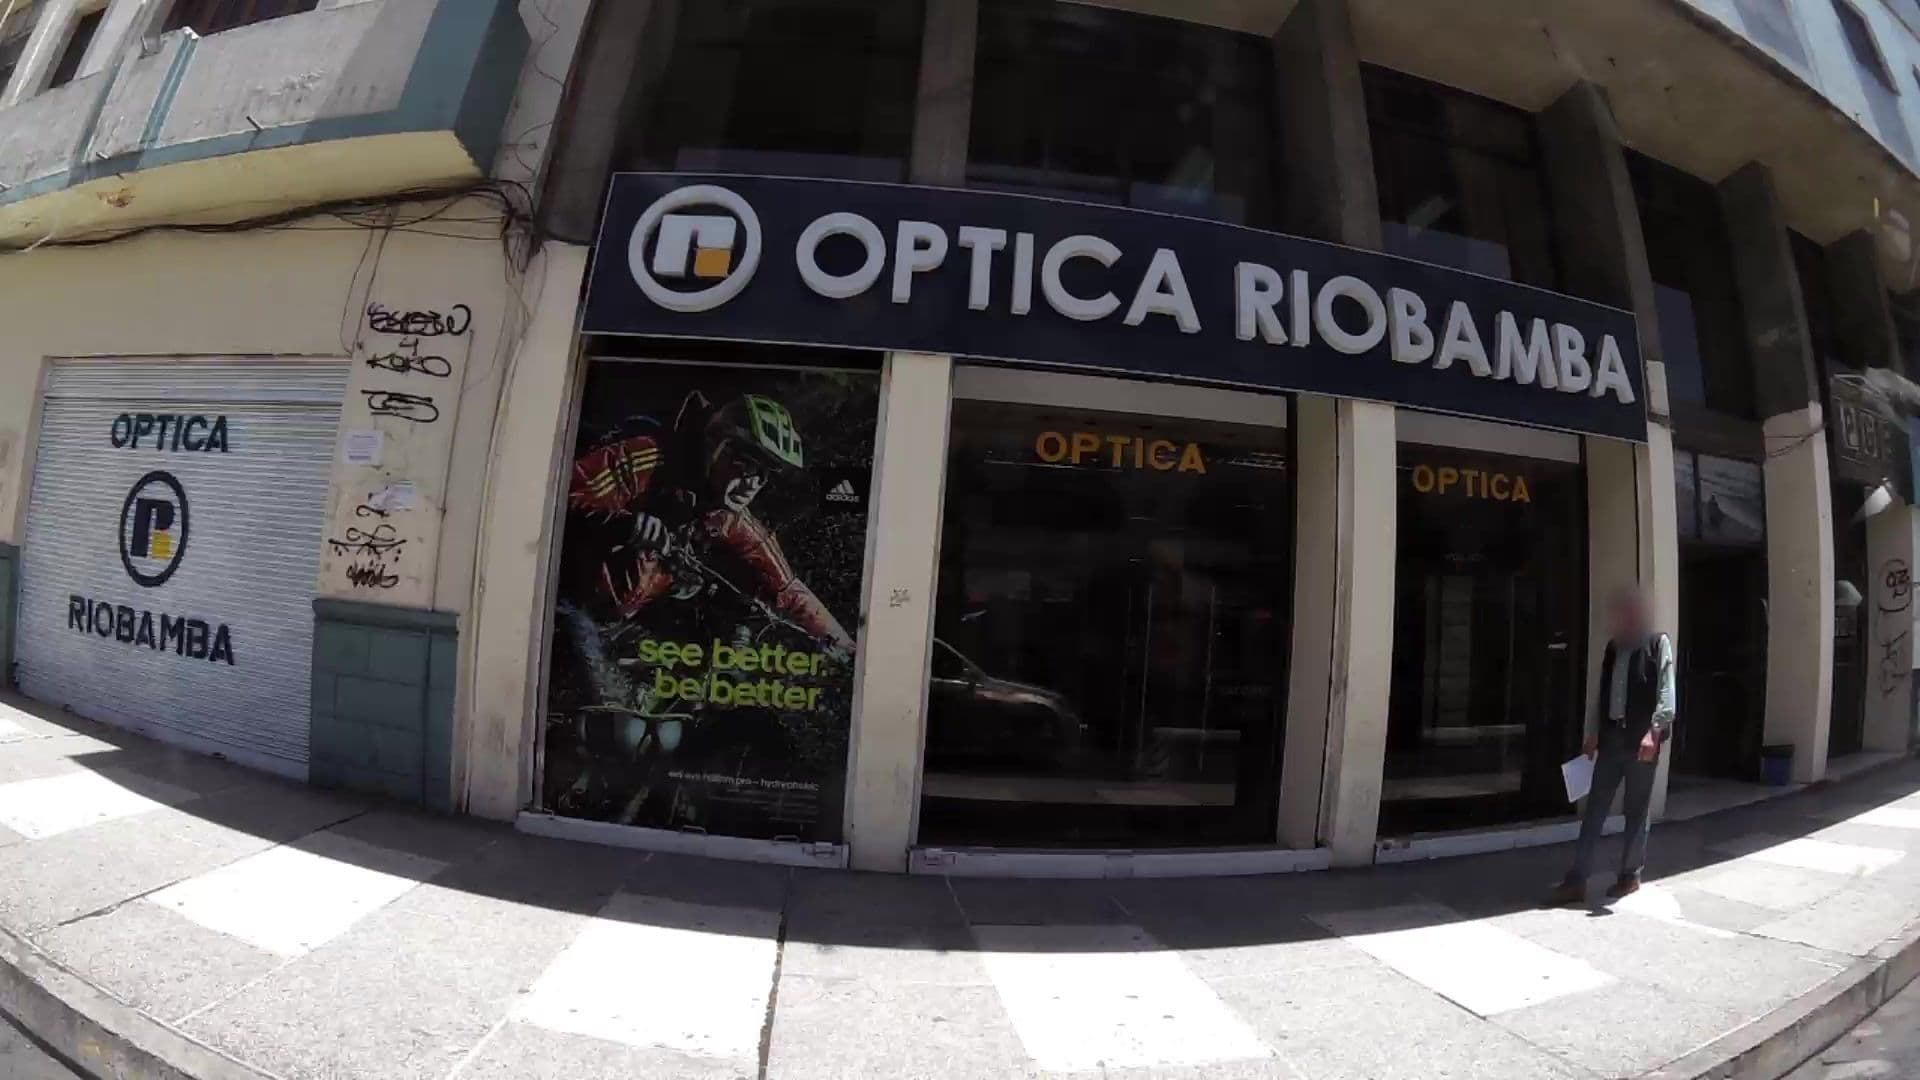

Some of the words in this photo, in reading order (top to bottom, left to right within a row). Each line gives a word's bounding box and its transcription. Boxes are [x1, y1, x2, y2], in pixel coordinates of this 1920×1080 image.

[796, 211, 1202, 334] OPTICA
[1233, 261, 1637, 404] RIOBAMBA
[111, 413, 229, 453] OPTICA
[1035, 431, 1208, 476] OPTICA
[825, 493, 861, 504] adidas
[1411, 464, 1532, 503] OPTICA
[68, 595, 236, 666] RIOBAMBA
[639, 639, 704, 667] see
[656, 667, 701, 701] be
